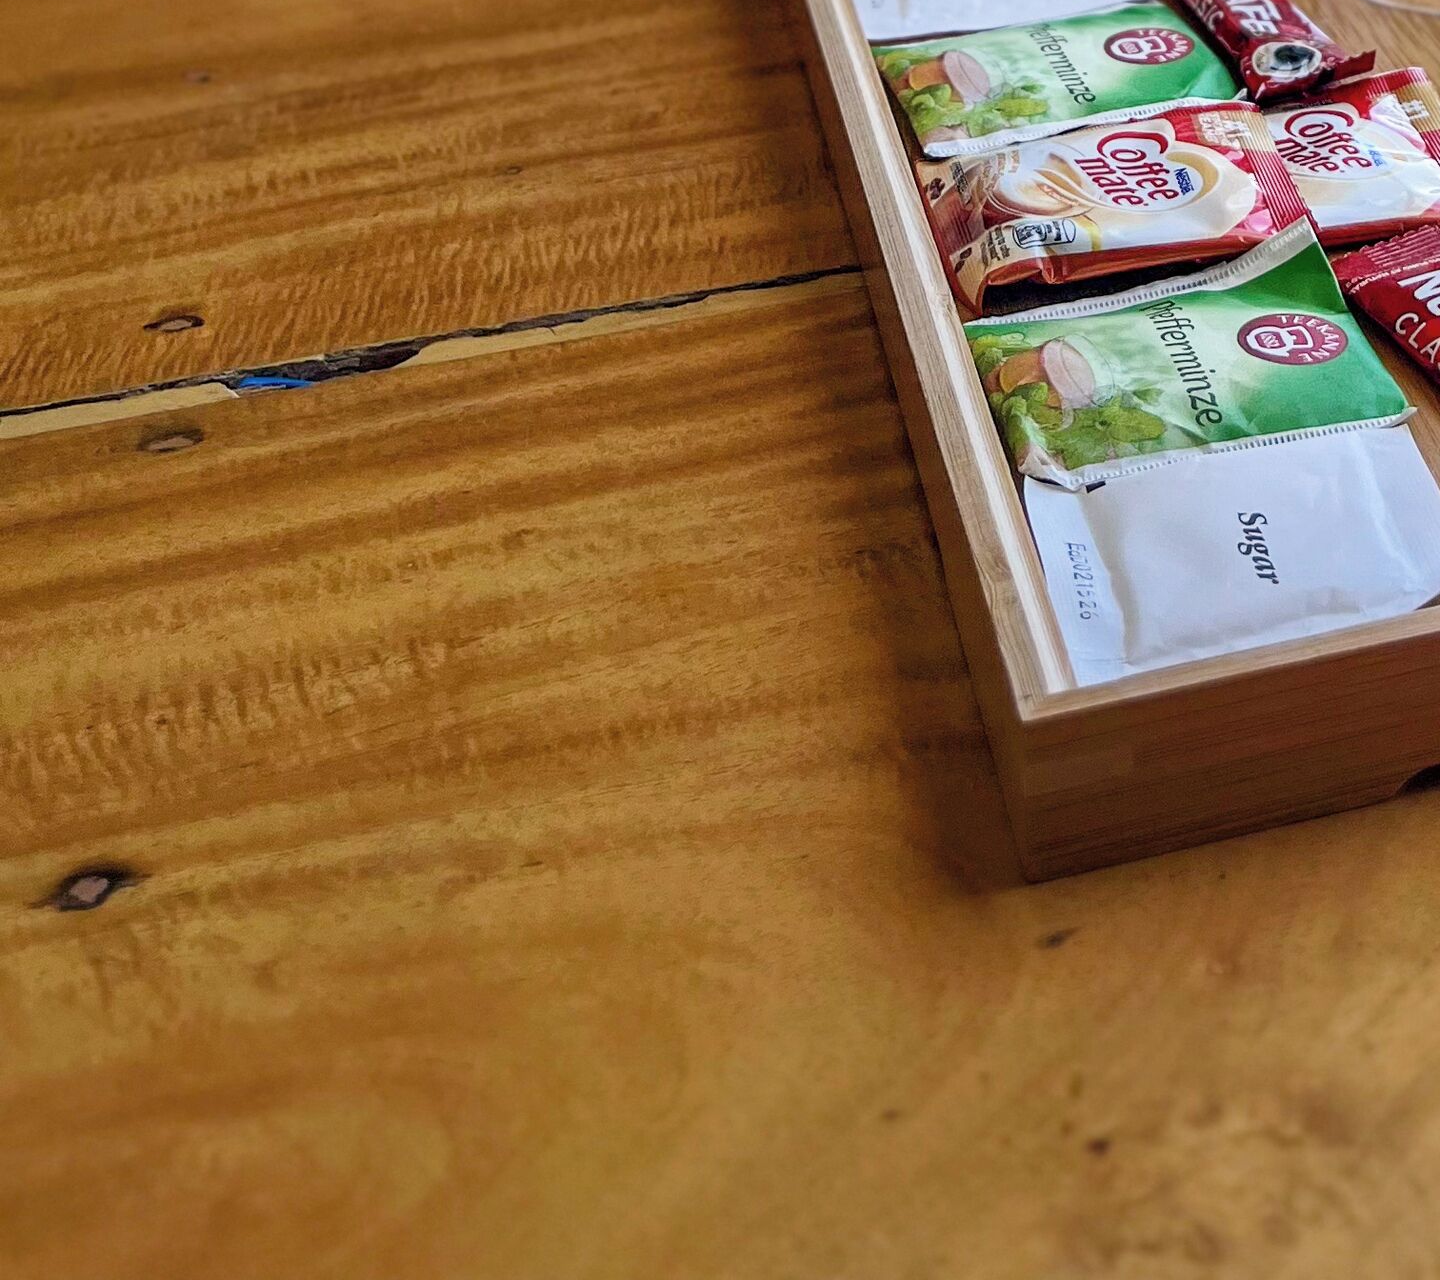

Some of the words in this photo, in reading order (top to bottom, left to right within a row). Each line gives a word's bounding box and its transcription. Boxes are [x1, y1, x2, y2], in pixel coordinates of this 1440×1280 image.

[1097, 131, 1180, 201] Coffee
[1284, 108, 1373, 170] Coffee
[1074, 156, 1149, 207] mate
[1276, 314, 1341, 362] TEEKANNE
[1237, 512, 1280, 585] Sugar
